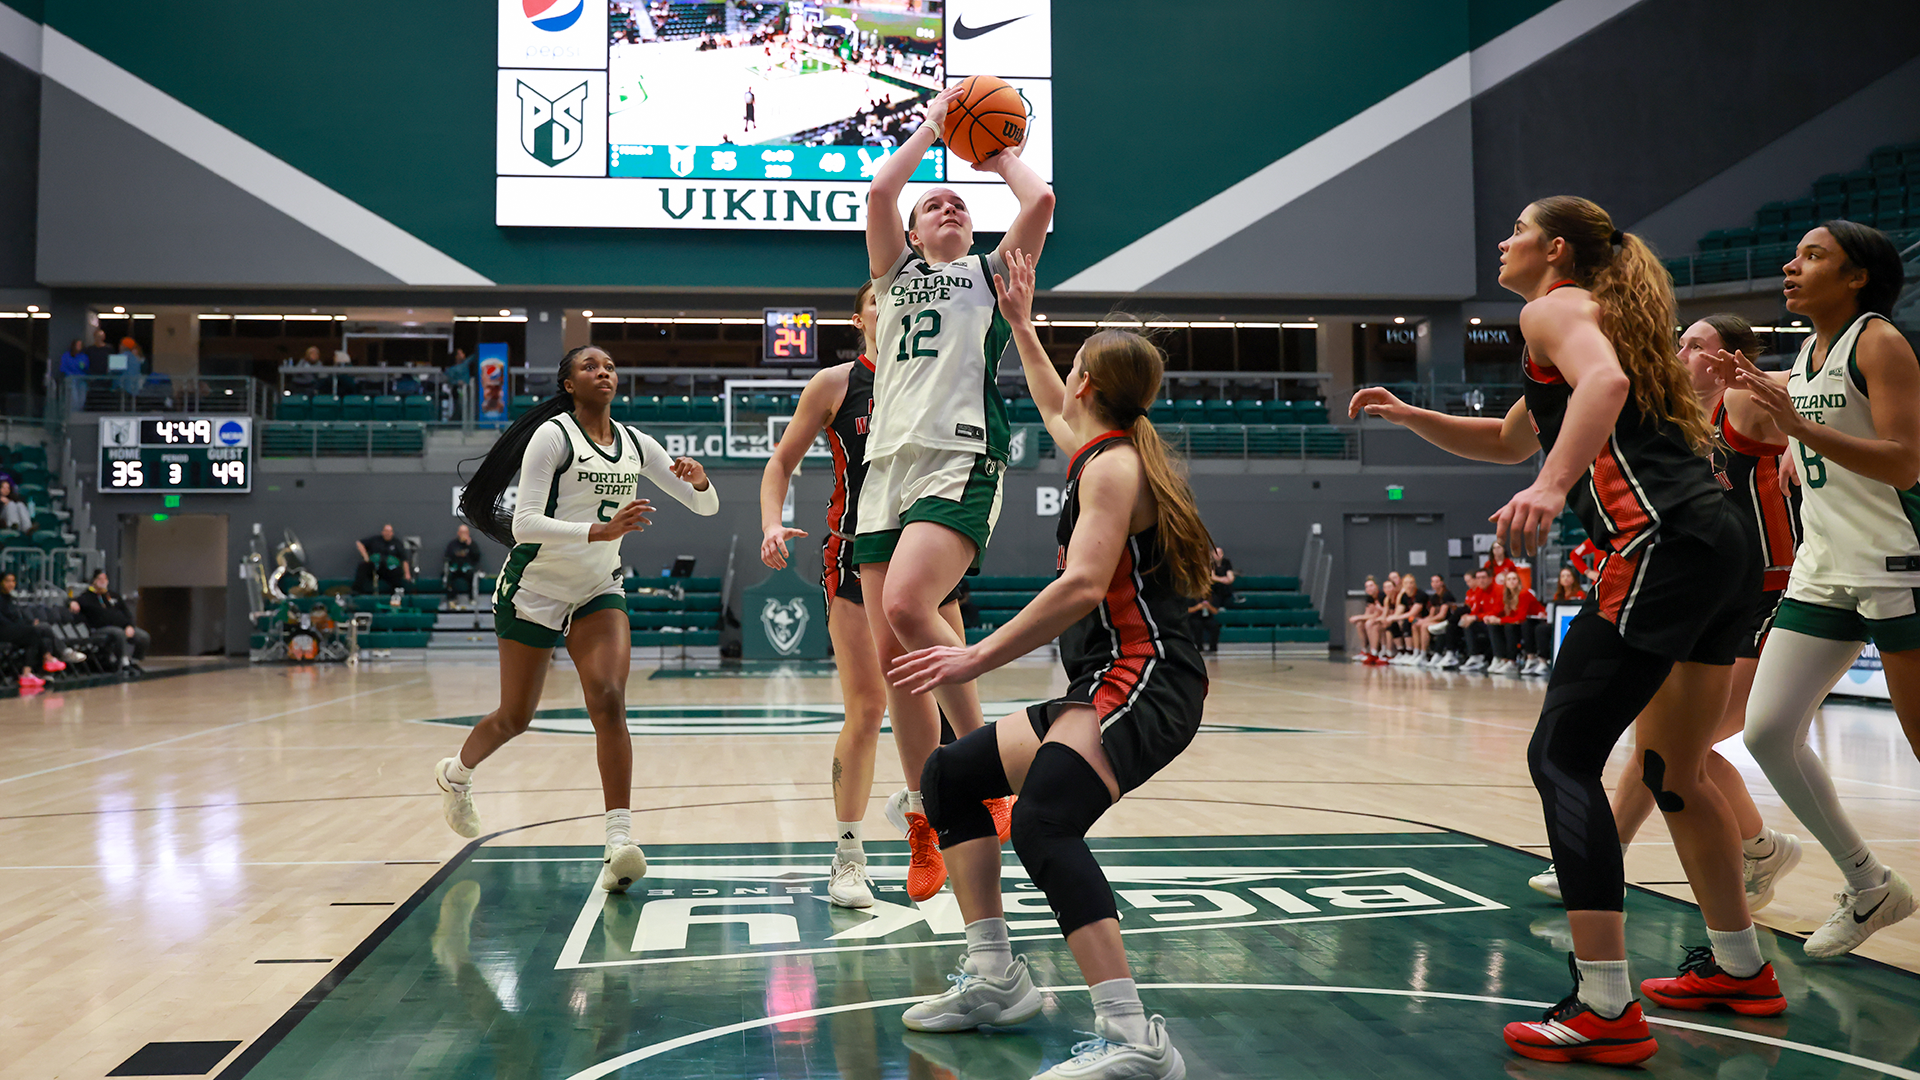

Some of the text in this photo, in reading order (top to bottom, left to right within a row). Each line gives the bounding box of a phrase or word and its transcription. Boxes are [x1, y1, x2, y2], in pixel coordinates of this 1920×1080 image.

[526, 46, 580, 60] pepsi
[1002, 120, 1024, 142] Wil
[658, 187, 870, 222] VIKING
[894, 287, 951, 307] STATE
[774, 328, 807, 356] 24
[896, 309, 942, 362] 12
[156, 420, 211, 444] 4:49
[108, 449, 141, 460] HOME
[161, 454, 189, 463] PERIOD
[207, 449, 243, 460] GUEST
[112, 461, 144, 487] 35
[169, 463, 182, 485] 3
[212, 461, 245, 486] 49
[577, 471, 639, 484] PORTLAN
[594, 484, 633, 495] STATE
